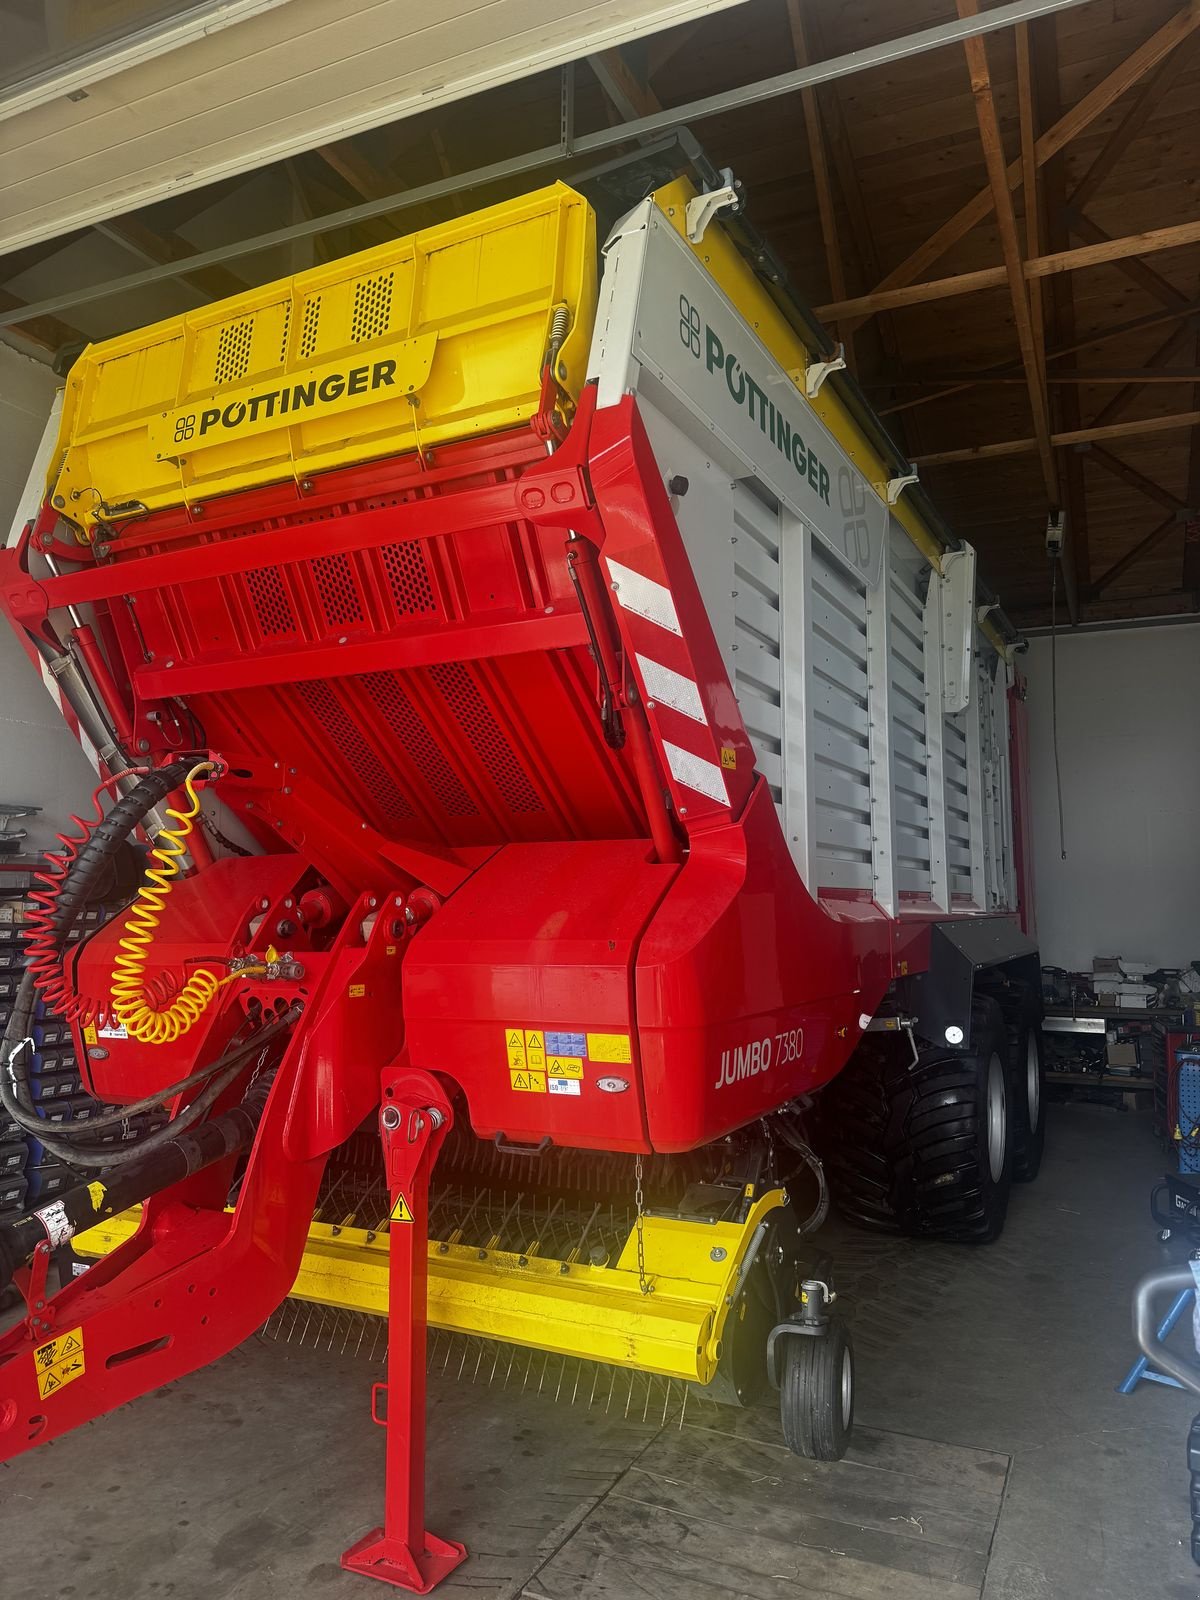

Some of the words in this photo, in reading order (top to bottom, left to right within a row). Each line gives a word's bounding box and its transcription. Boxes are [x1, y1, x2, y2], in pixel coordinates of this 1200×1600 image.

[199, 359, 397, 436] PÖTTINGER
[706, 324, 830, 507] PÖTTINGER
[715, 1038, 772, 1090] JUMBO
[775, 1028, 804, 1067] 7380
